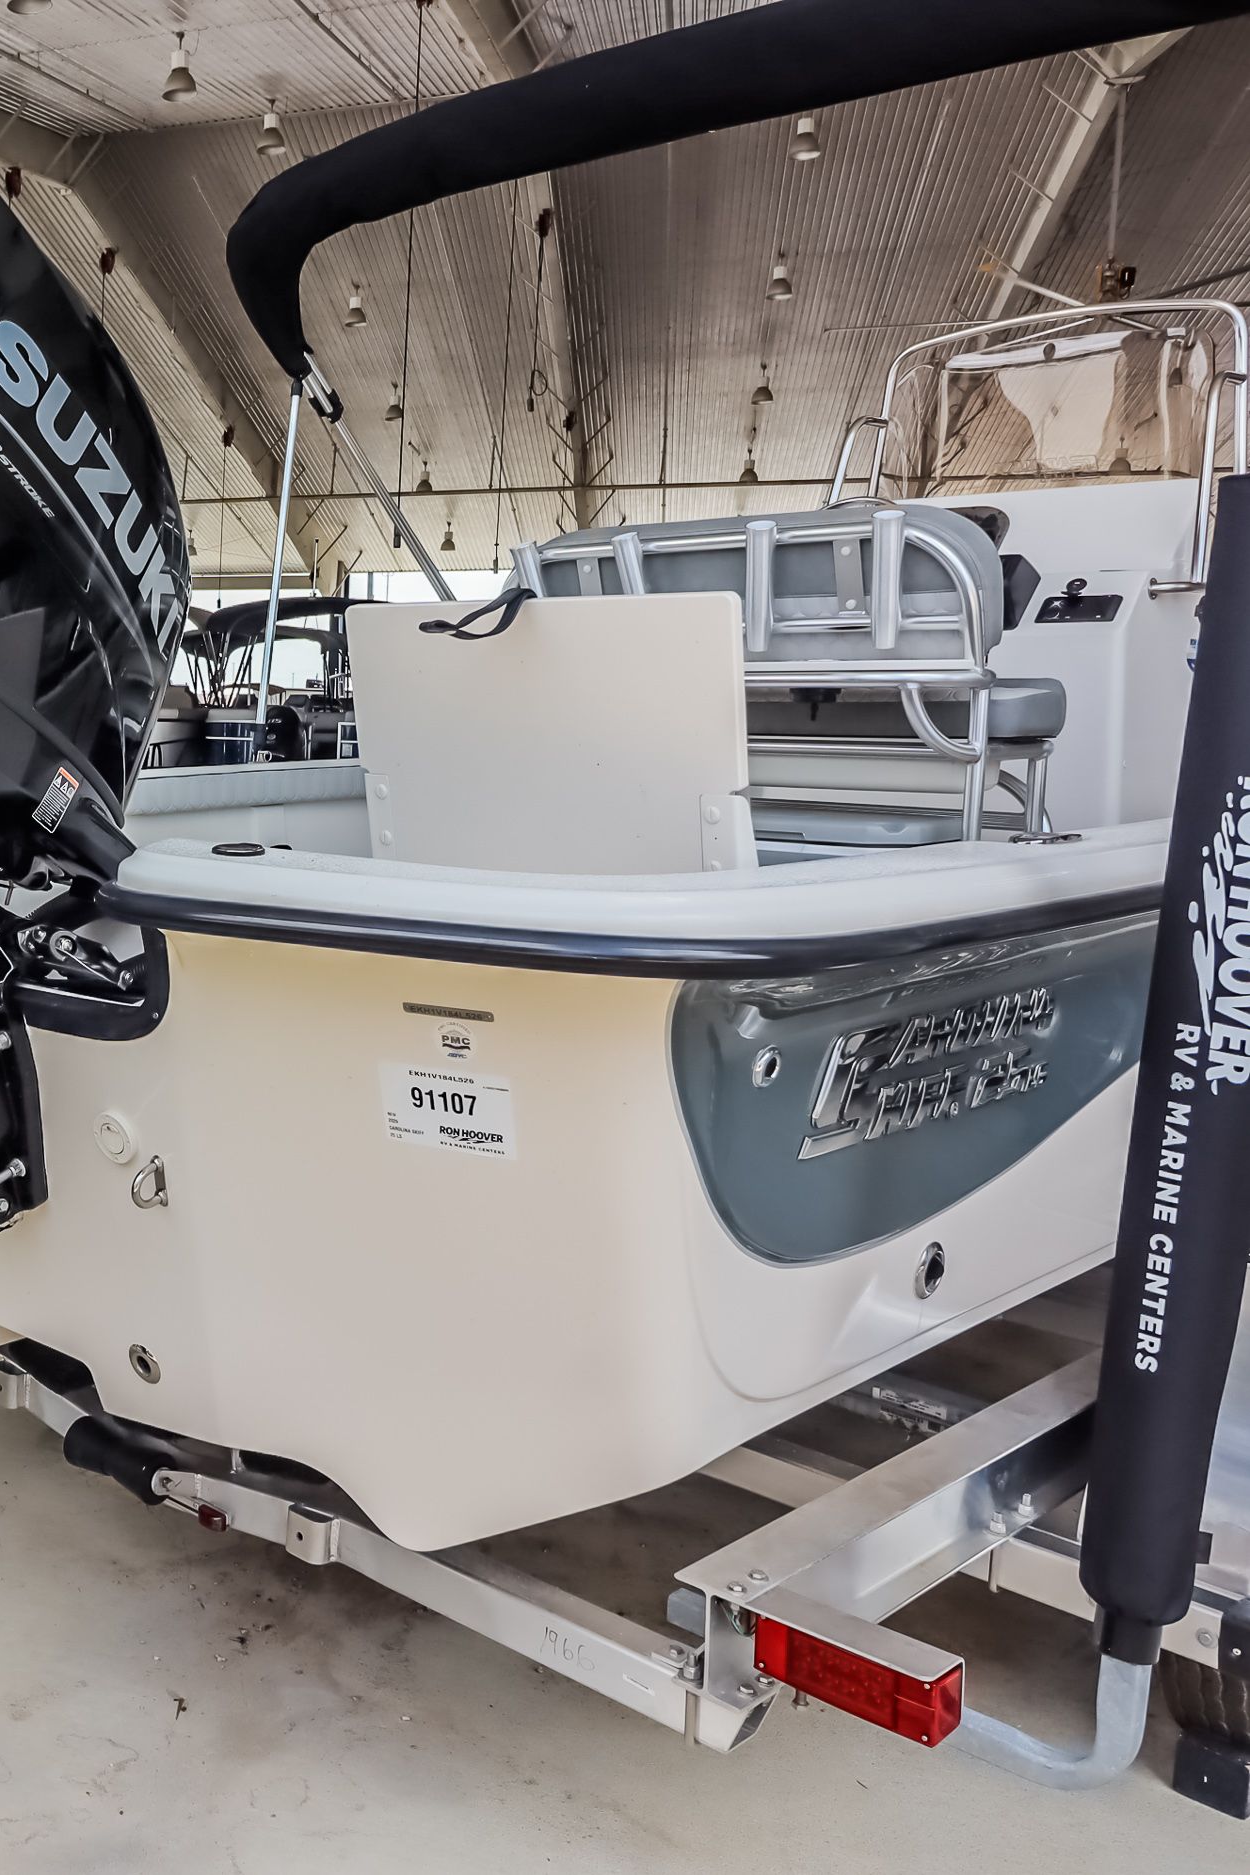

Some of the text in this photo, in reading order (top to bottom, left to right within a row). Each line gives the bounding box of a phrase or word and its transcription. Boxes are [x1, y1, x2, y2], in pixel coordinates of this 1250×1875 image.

[441, 1034, 471, 1046] PMC
[410, 1086, 477, 1117] 91107
[439, 1125, 504, 1144] RON HOOVER
[1134, 1022, 1201, 1374] RV & MARINE CENTERS
